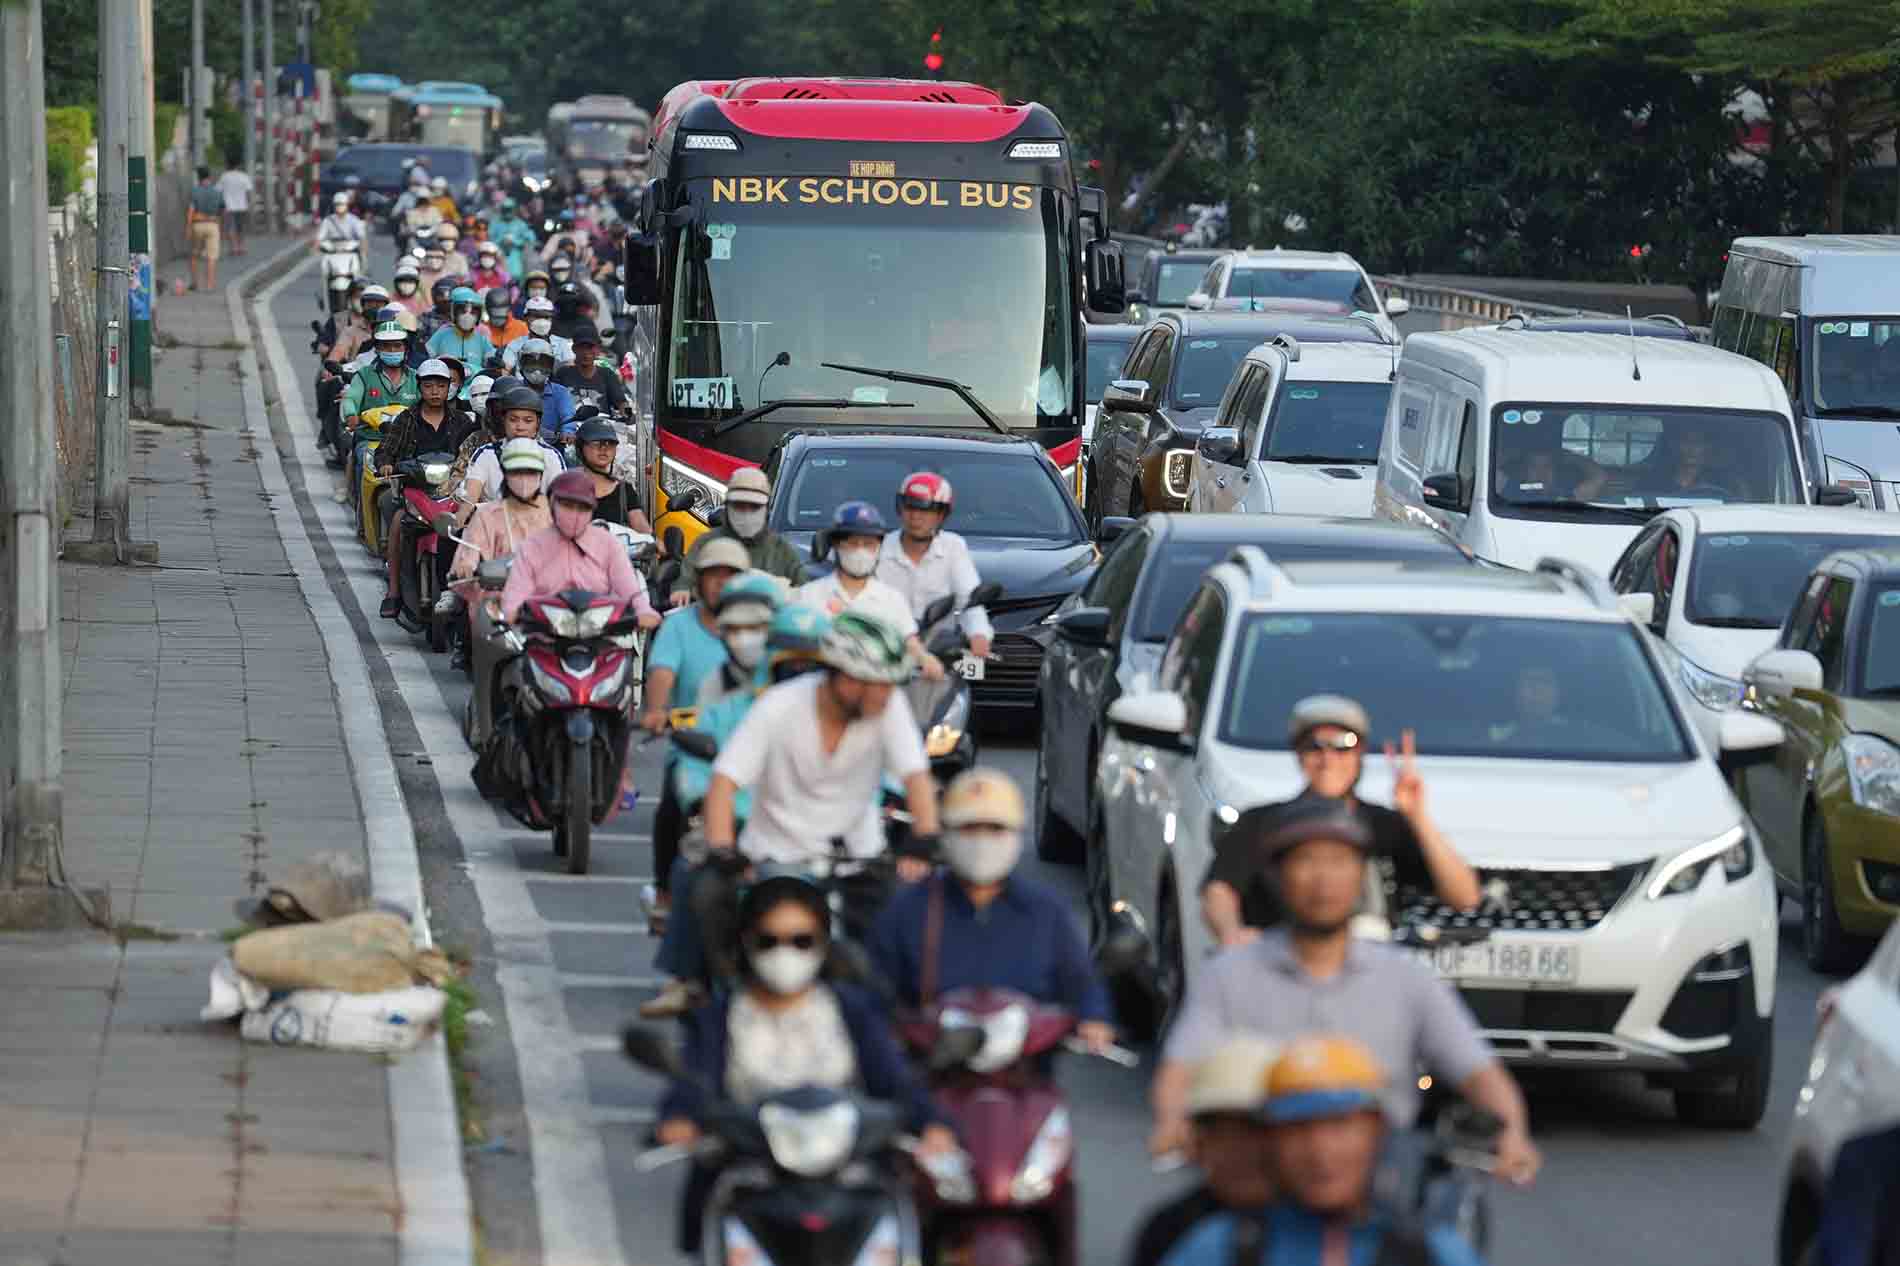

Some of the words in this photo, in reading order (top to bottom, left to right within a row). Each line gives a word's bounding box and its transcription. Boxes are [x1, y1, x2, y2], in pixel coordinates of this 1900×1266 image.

[712, 178, 789, 203] NBK
[800, 178, 949, 206] SCHOOL
[960, 182, 1033, 209] BUS
[675, 383, 694, 408] PT
[708, 382, 726, 408] 50
